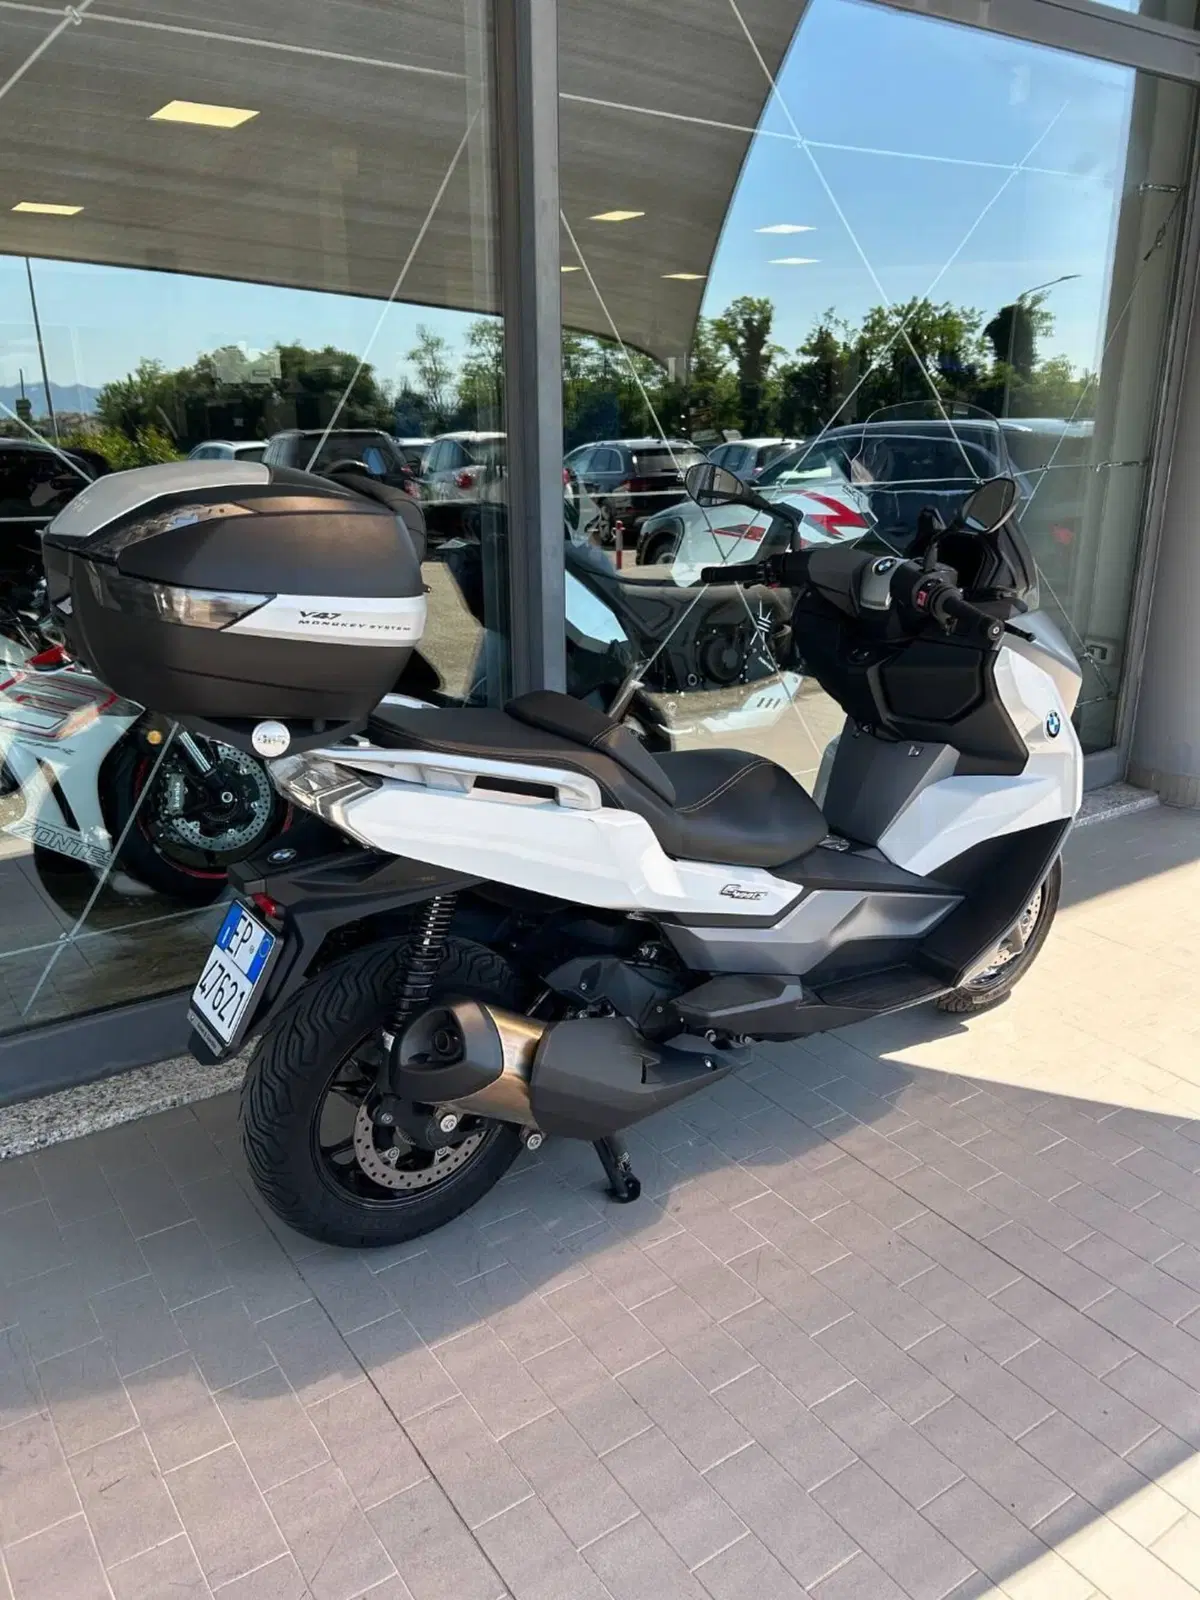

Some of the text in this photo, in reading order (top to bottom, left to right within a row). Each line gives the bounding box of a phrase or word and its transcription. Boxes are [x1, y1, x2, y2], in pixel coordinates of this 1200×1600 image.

[299, 611, 342, 620] V47
[226, 914, 254, 959] EP
[199, 960, 246, 1029] 47621
